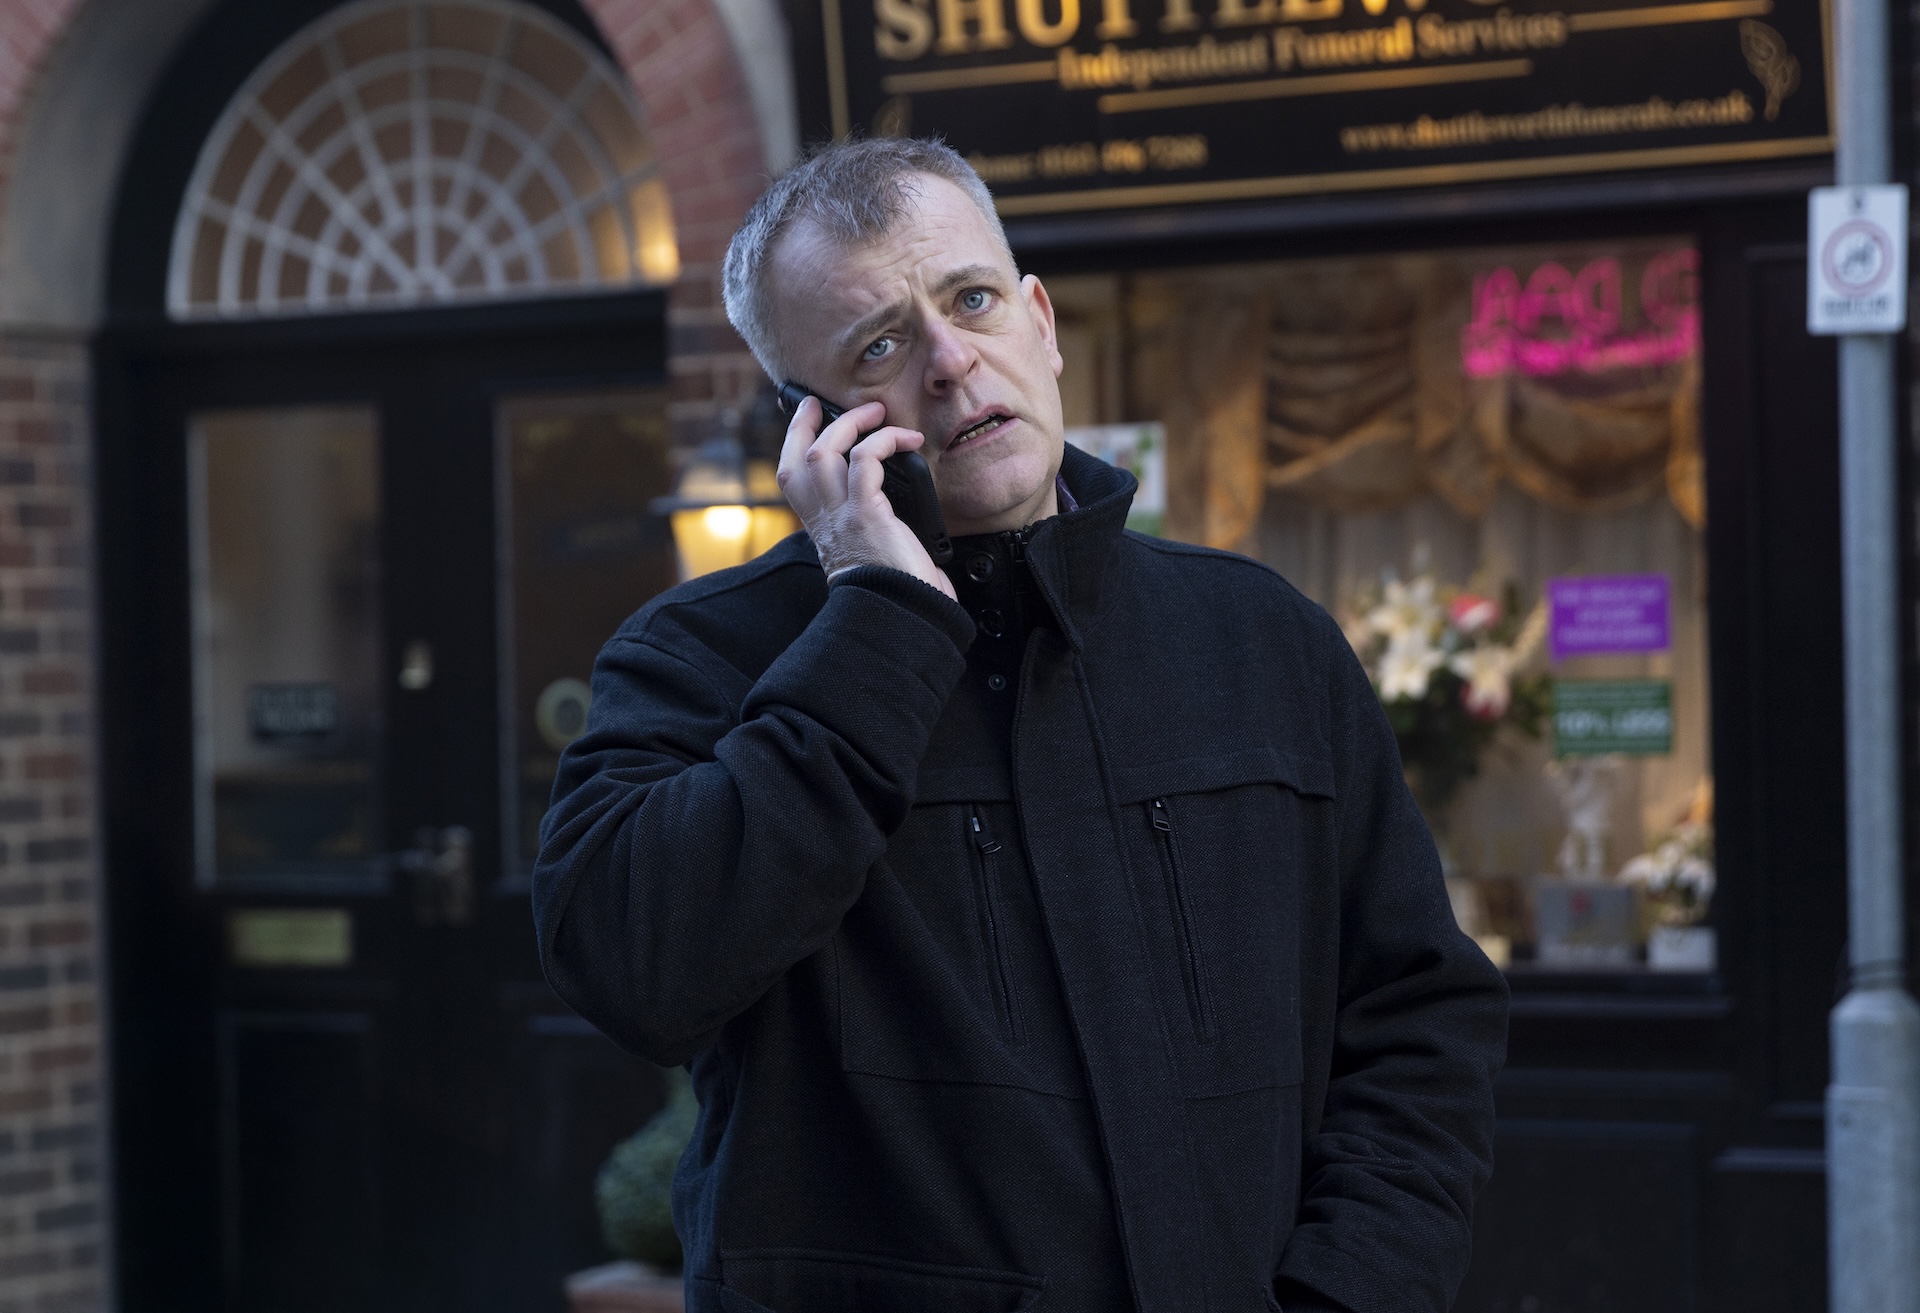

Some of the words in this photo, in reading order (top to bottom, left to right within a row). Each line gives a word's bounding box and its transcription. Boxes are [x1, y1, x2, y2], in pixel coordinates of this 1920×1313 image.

[1058, 35, 1270, 91] Independent
[1274, 16, 1414, 70] Funeral
[1416, 9, 1567, 58] Services
